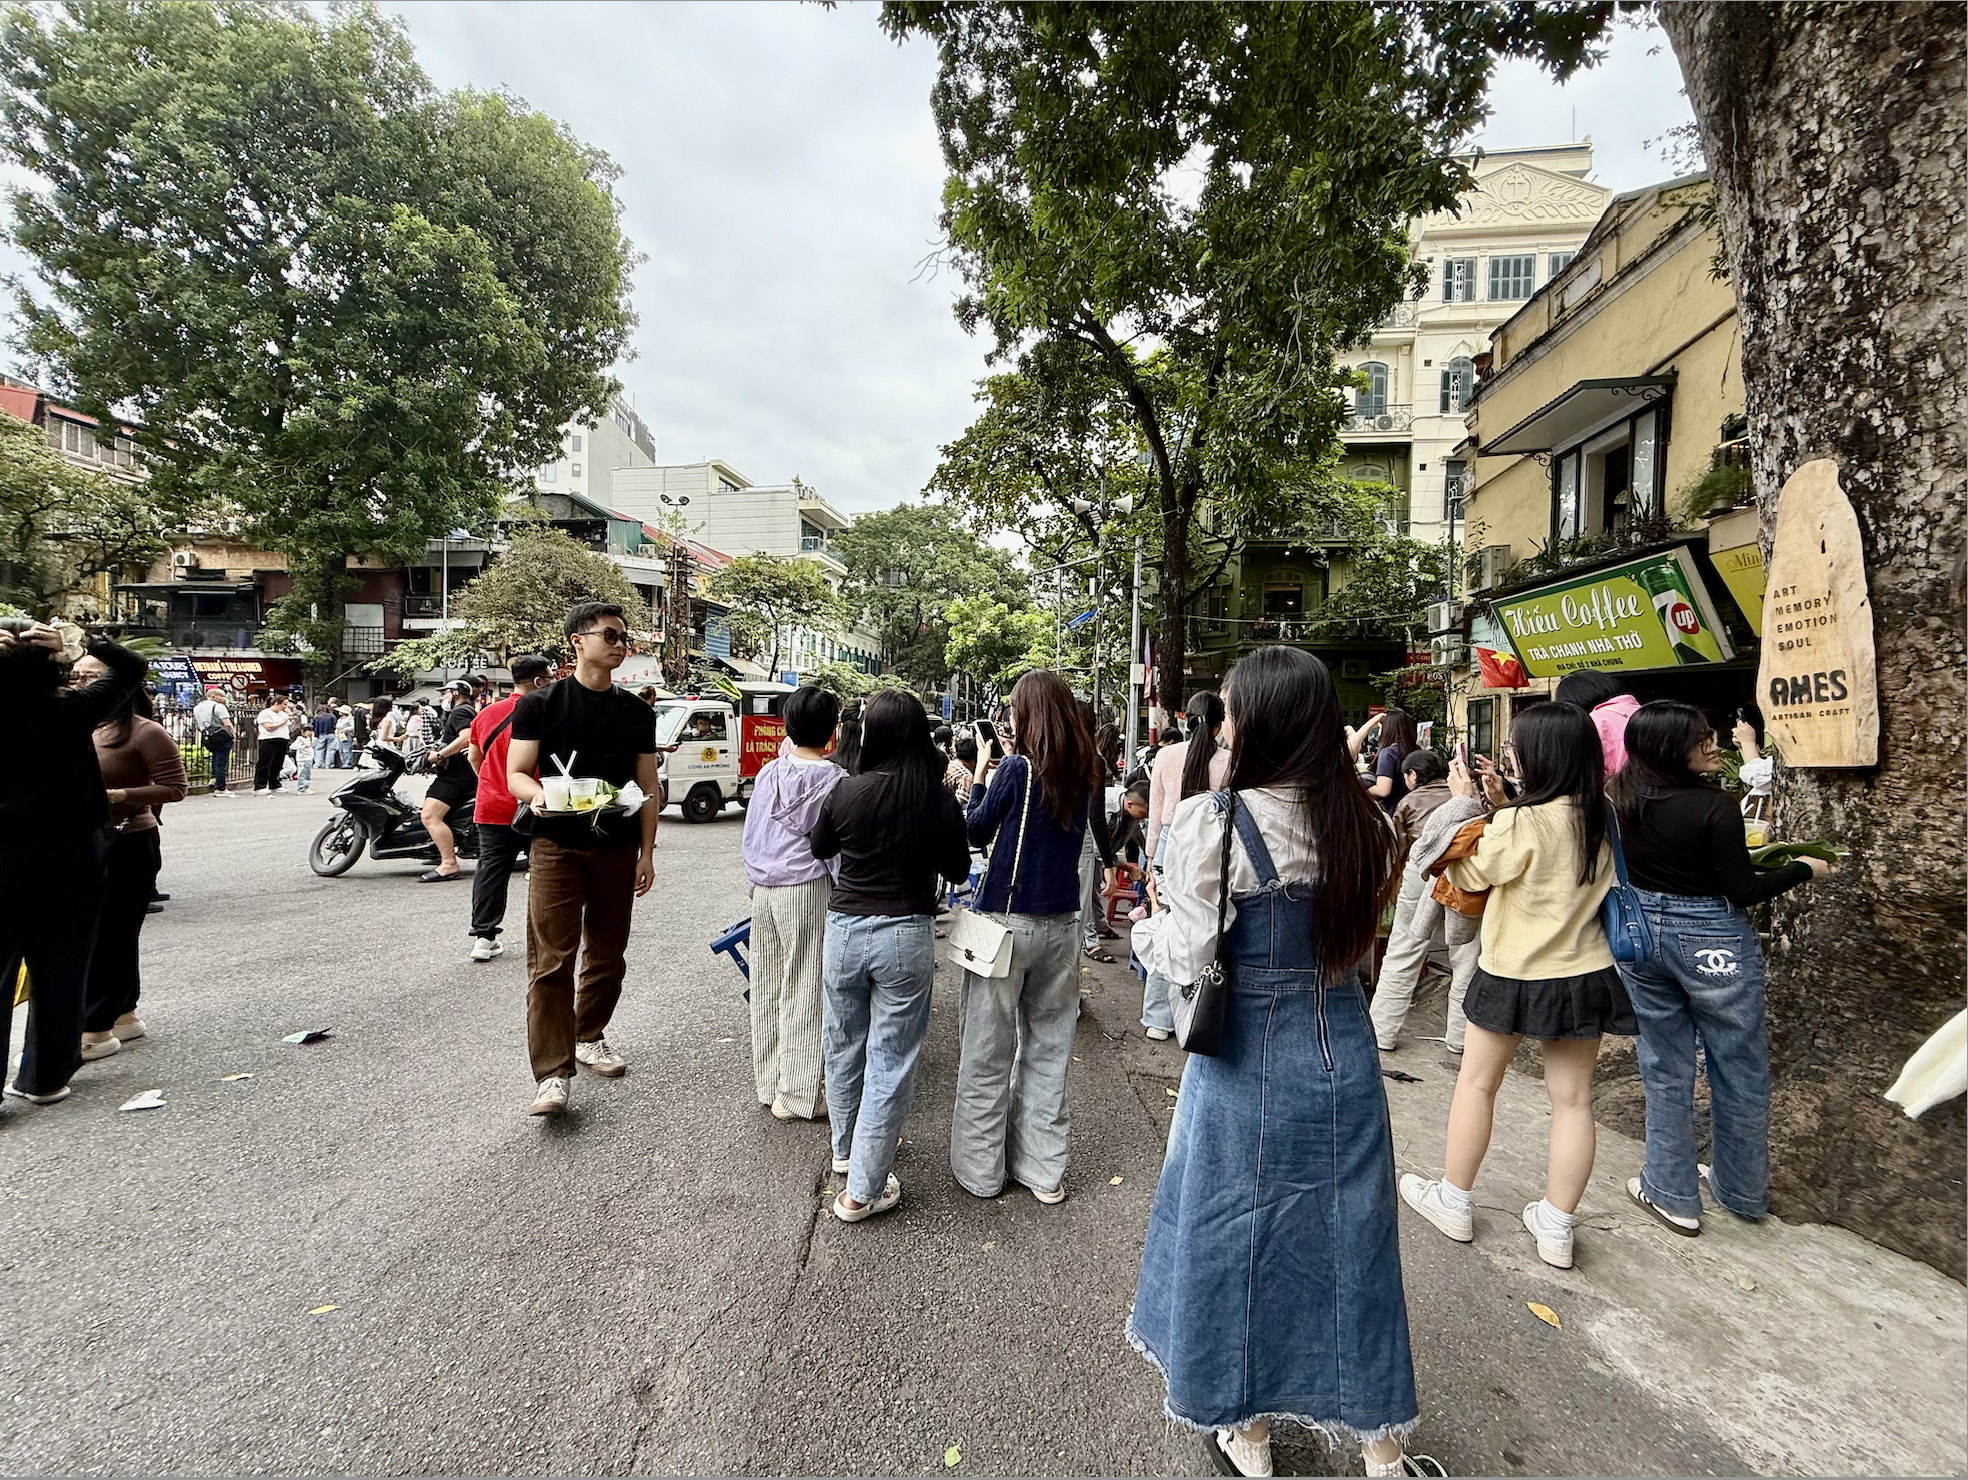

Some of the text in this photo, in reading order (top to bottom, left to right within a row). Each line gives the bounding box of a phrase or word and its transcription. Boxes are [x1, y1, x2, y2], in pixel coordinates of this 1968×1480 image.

[1773, 585, 1797, 599] ART
[1505, 586, 1644, 638] Hiếu Coffee
[1775, 596, 1831, 616] MEMORY
[1777, 614, 1838, 633] EMOTION
[1527, 630, 1643, 661] TRÀ CHANH NHÀ THỜ
[1778, 637, 1812, 651] SOUL
[1602, 657, 1624, 666] CHUNG
[1769, 669, 1848, 707] AMES
[1772, 708, 1850, 721] ARTISAN CRAFT
[755, 739, 777, 753] TRÁCH
